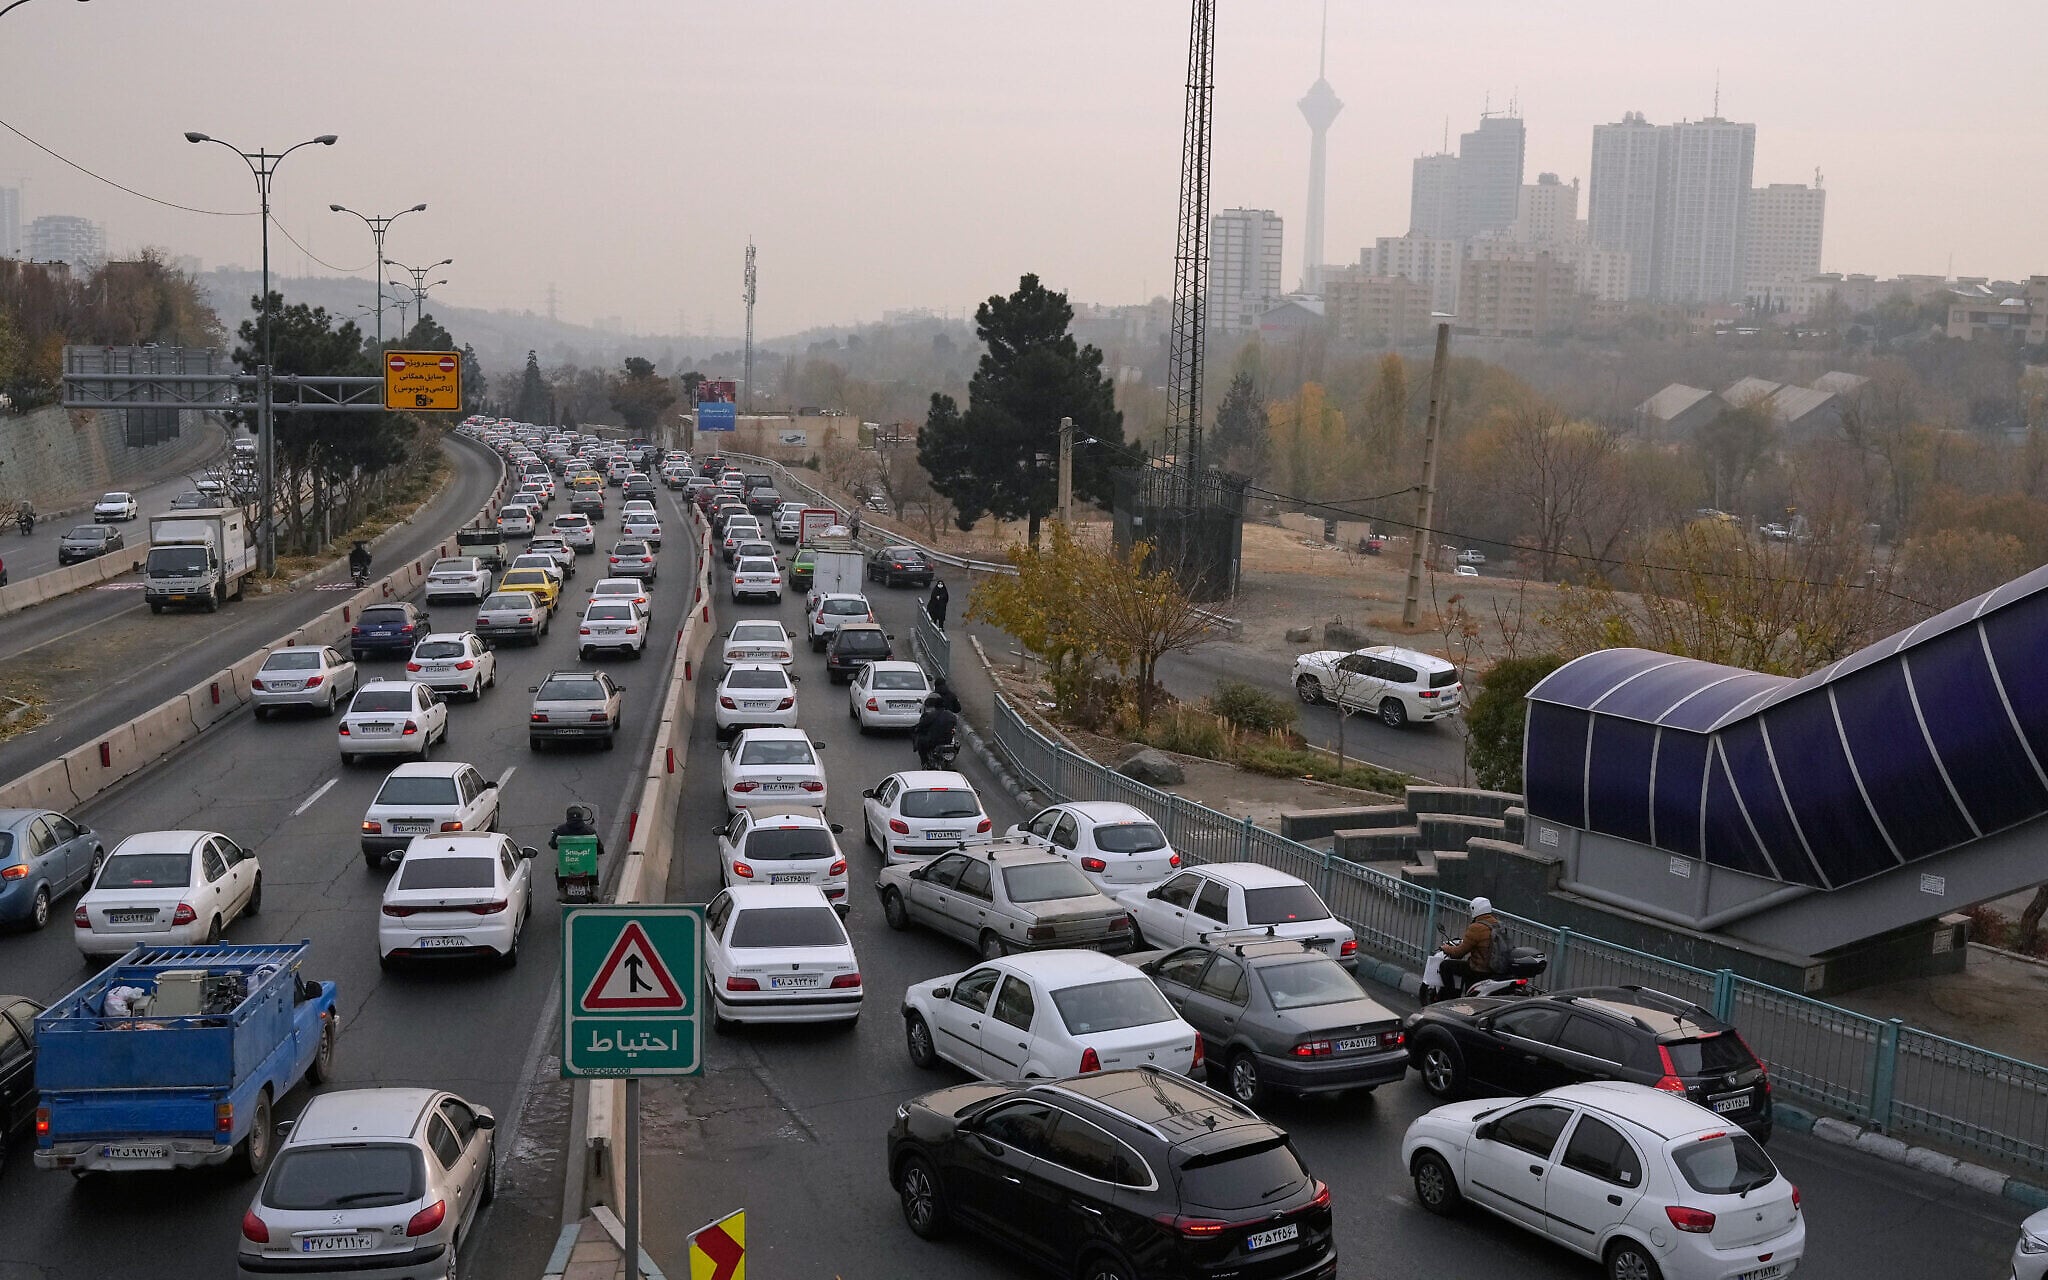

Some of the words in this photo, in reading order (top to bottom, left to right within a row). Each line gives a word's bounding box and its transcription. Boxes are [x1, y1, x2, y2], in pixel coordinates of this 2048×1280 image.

[400, 372, 424, 380] همگانی
[425, 373, 446, 382] وسایل
[586, 1028, 678, 1058] احتیاط
[310, 1238, 324, 1250] ۳۷
[326, 1238, 334, 1248] ل
[336, 1237, 355, 1248] ۳۱۱
[358, 1238, 370, 1248] ۳۰
